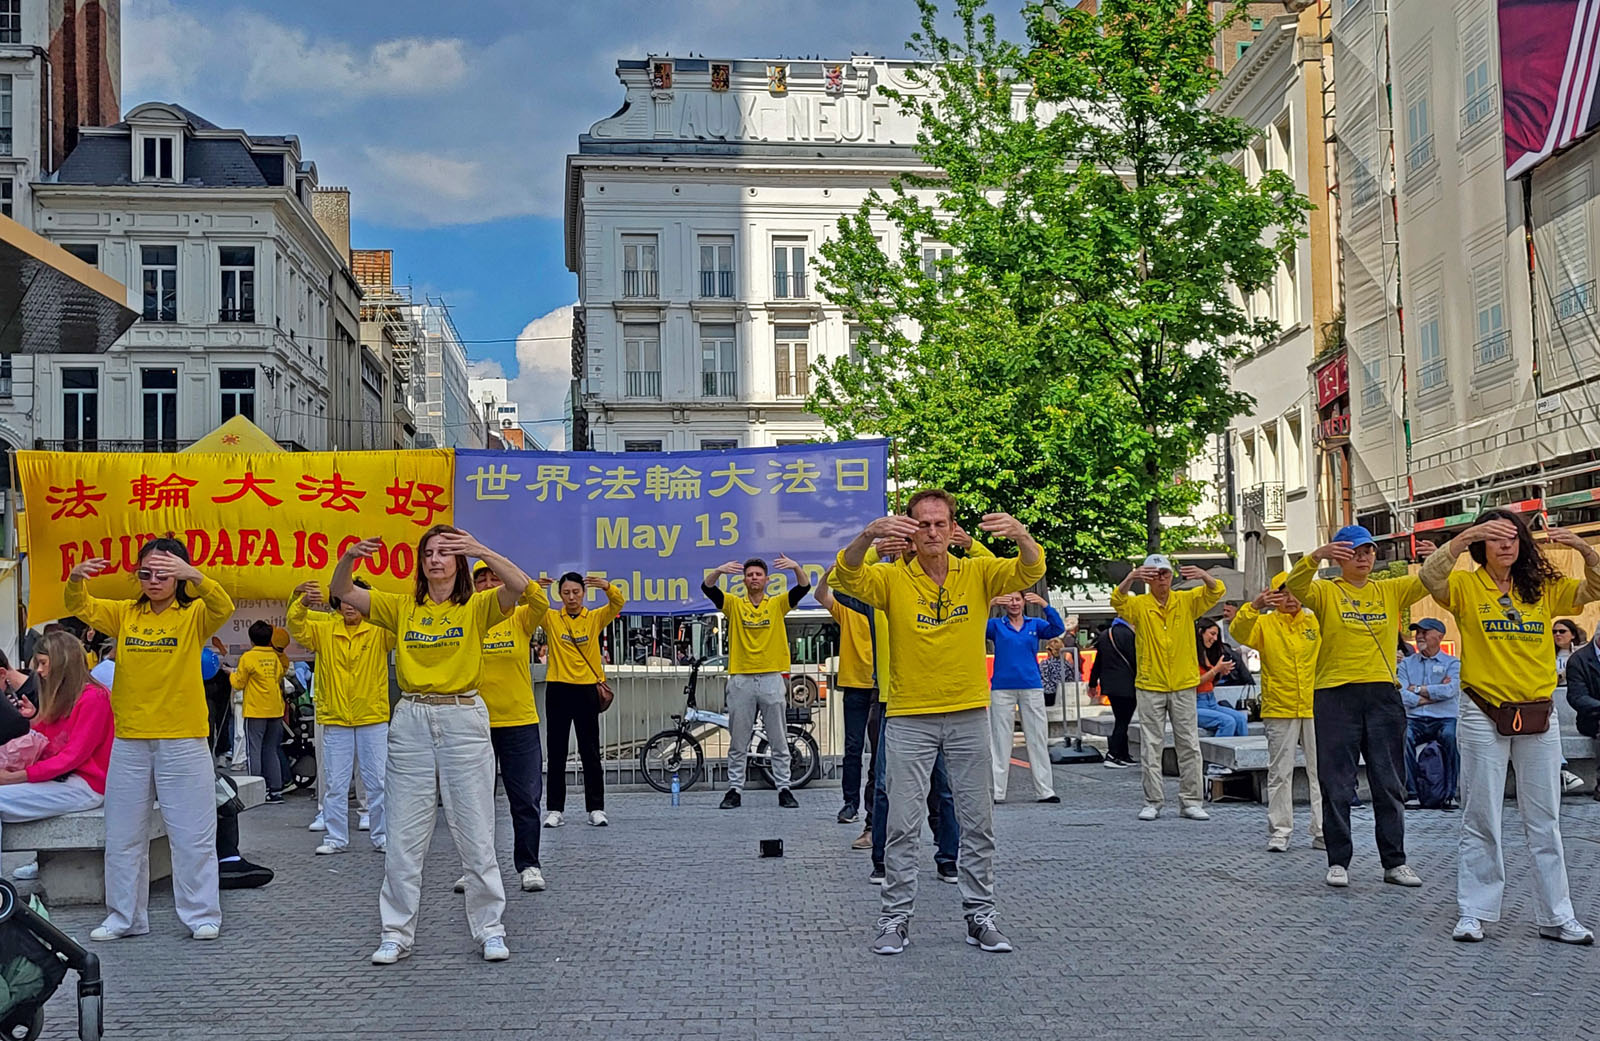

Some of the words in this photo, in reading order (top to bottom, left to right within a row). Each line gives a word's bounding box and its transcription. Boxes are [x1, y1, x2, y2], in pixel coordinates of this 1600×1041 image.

[679, 94, 760, 140] AUX
[786, 97, 890, 143] NEUF
[46, 472, 449, 526] 法輪大法好
[466, 458, 869, 502] 世界法輪大法日
[59, 531, 176, 582] FALU
[185, 528, 284, 567] DAFA
[292, 530, 329, 570] IS
[337, 534, 419, 580] GOO
[596, 516, 682, 558] May
[695, 511, 739, 548] 13
[703, 567, 788, 599] Daa
[952, 606, 968, 616] AFA
[1482, 621, 1521, 631] FALUN
